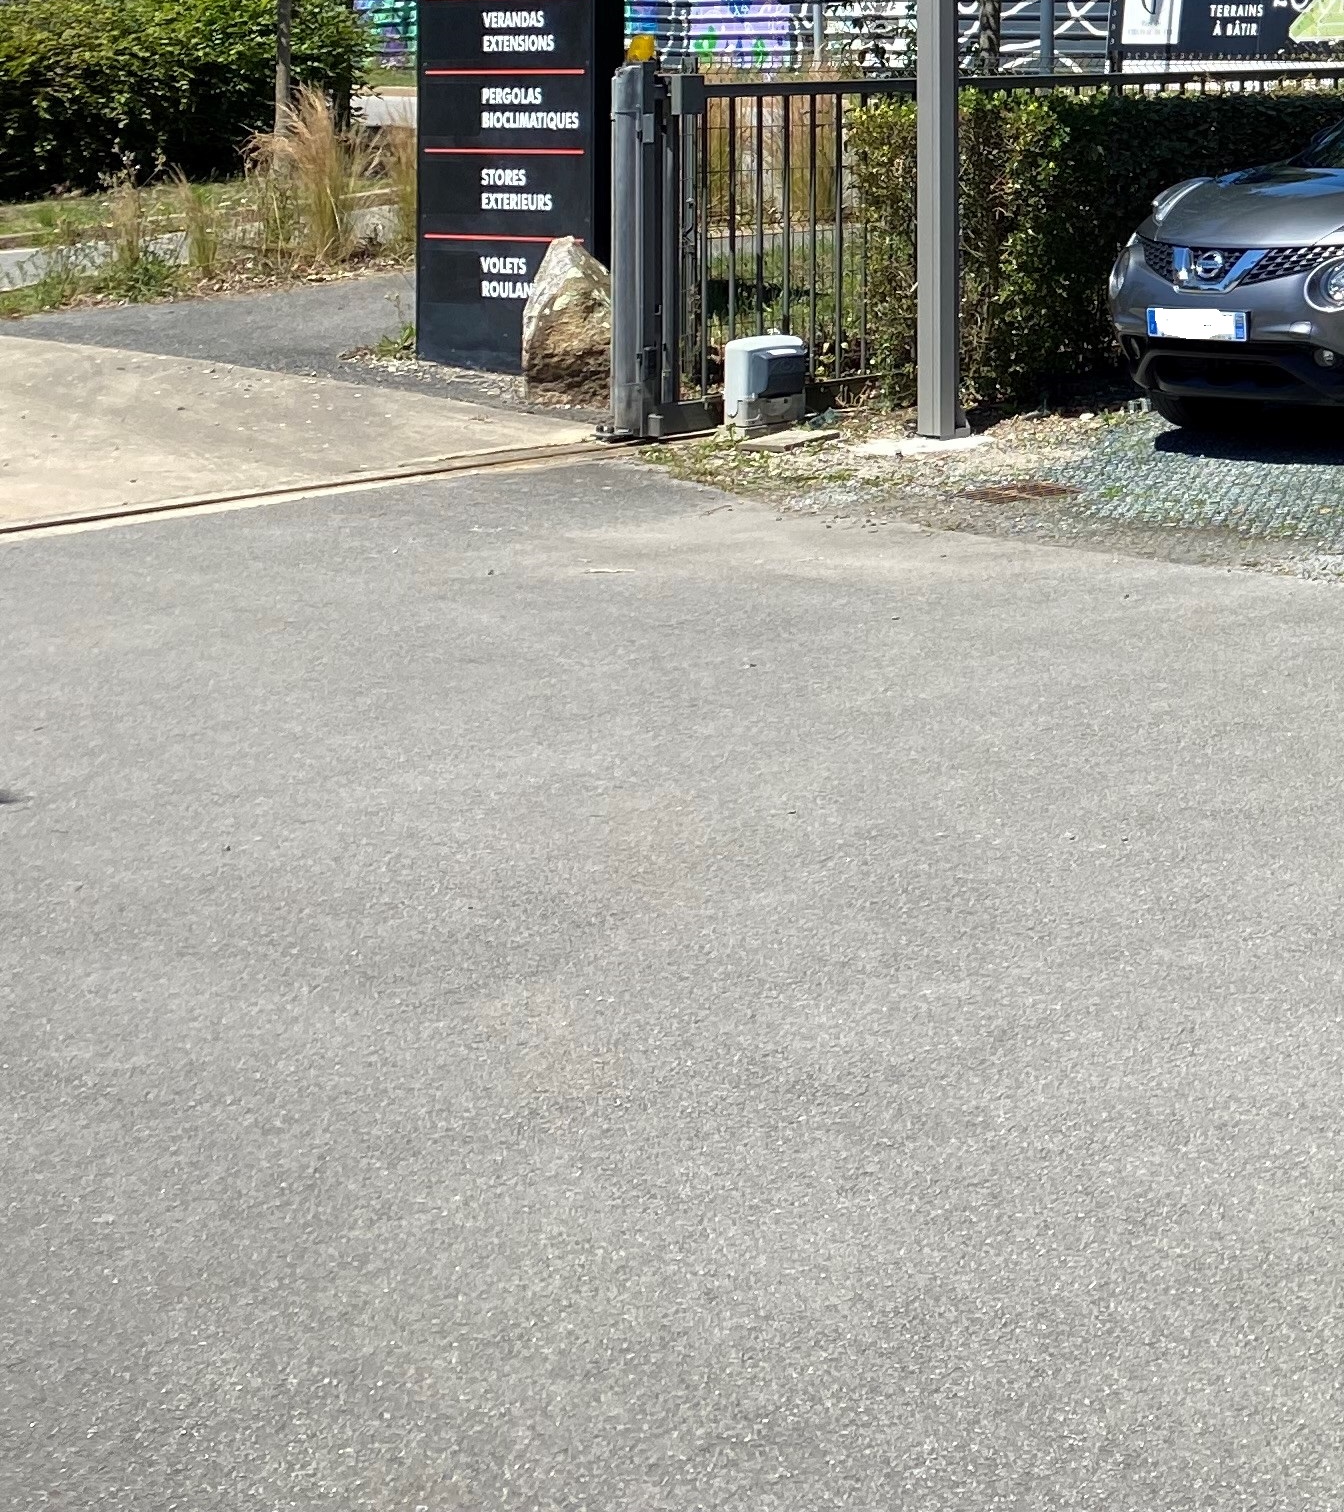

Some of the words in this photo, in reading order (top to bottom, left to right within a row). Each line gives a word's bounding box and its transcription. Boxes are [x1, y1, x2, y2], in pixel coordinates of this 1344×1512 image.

[1209, 4, 1264, 17] TERRAINS
[483, 11, 544, 28] VERANDAS
[1212, 20, 1222, 36] À
[1226, 20, 1258, 36] BÂTIR
[482, 35, 554, 52] EXTENSIONS
[481, 88, 542, 105] PERGOLAS
[481, 111, 579, 130] BIOCLIMATIQUES
[481, 169, 526, 186] STORES
[481, 193, 552, 211] EXTERIEURS
[480, 256, 527, 274] VOLETS
[481, 280, 534, 299] ROULAN
